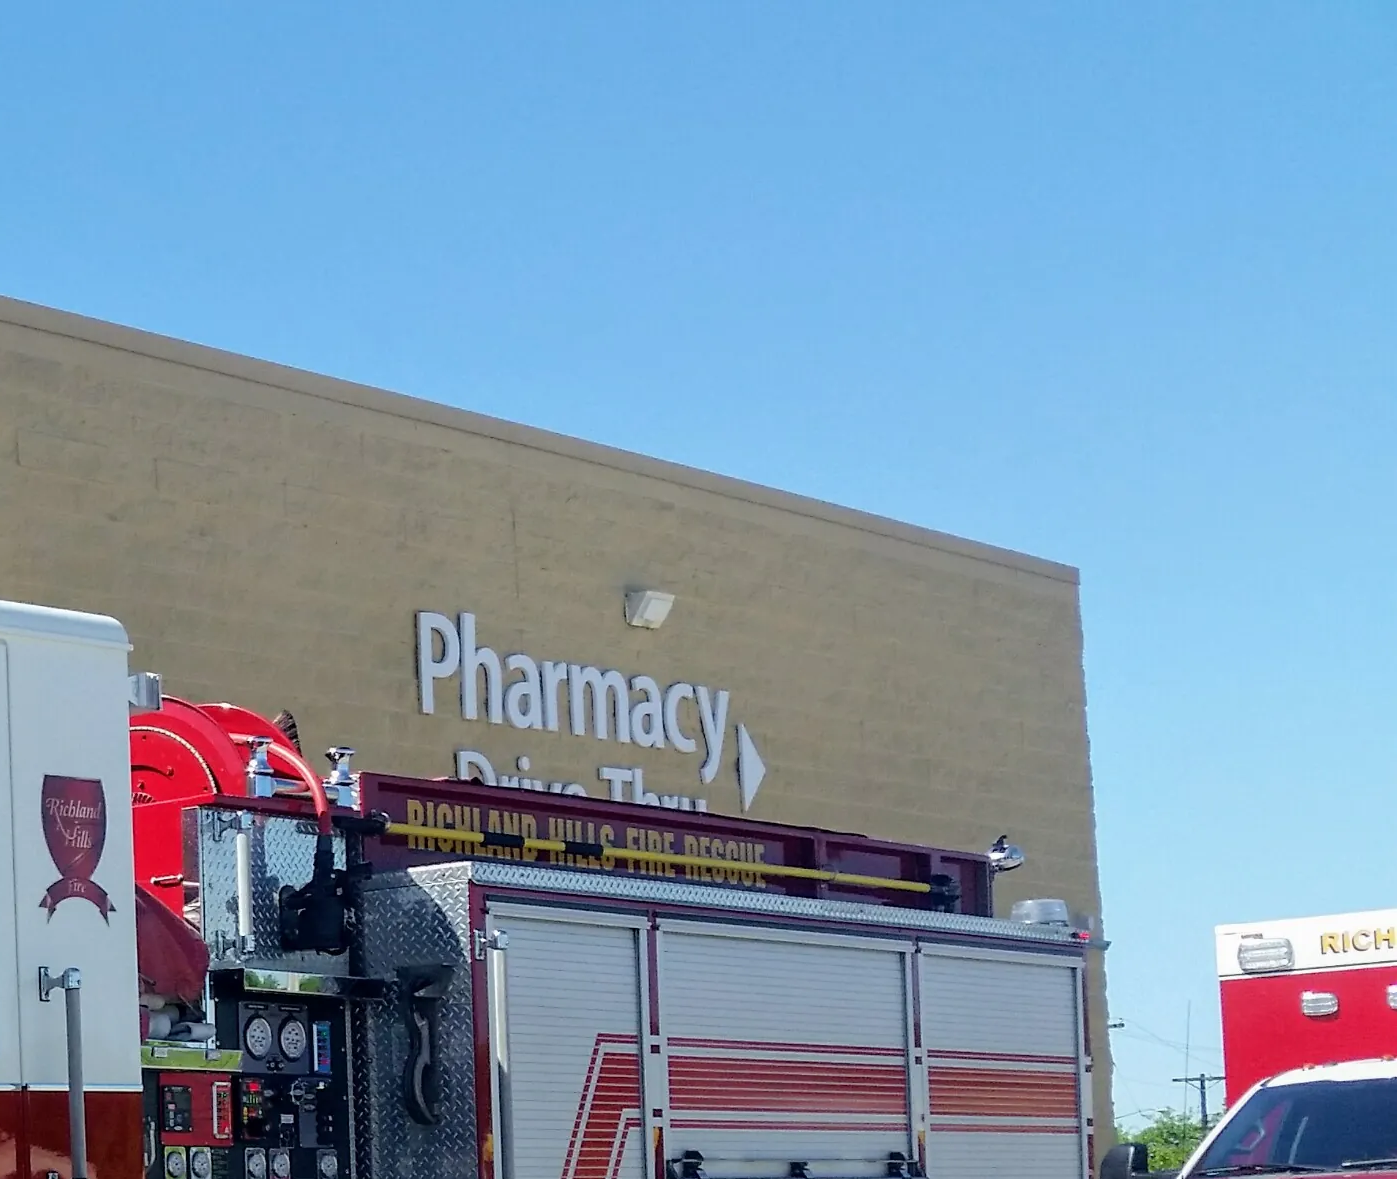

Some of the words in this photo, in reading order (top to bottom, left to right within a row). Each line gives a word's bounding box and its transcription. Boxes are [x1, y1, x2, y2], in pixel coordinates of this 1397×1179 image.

[416, 612, 729, 784] Pharmacy
[45, 797, 102, 820] Richland
[407, 799, 537, 863] RICHLAND
[549, 816, 616, 872] HILLS
[626, 826, 676, 878] FIRE
[684, 834, 767, 889] RESCUE
[1320, 927, 1397, 955] RICH
